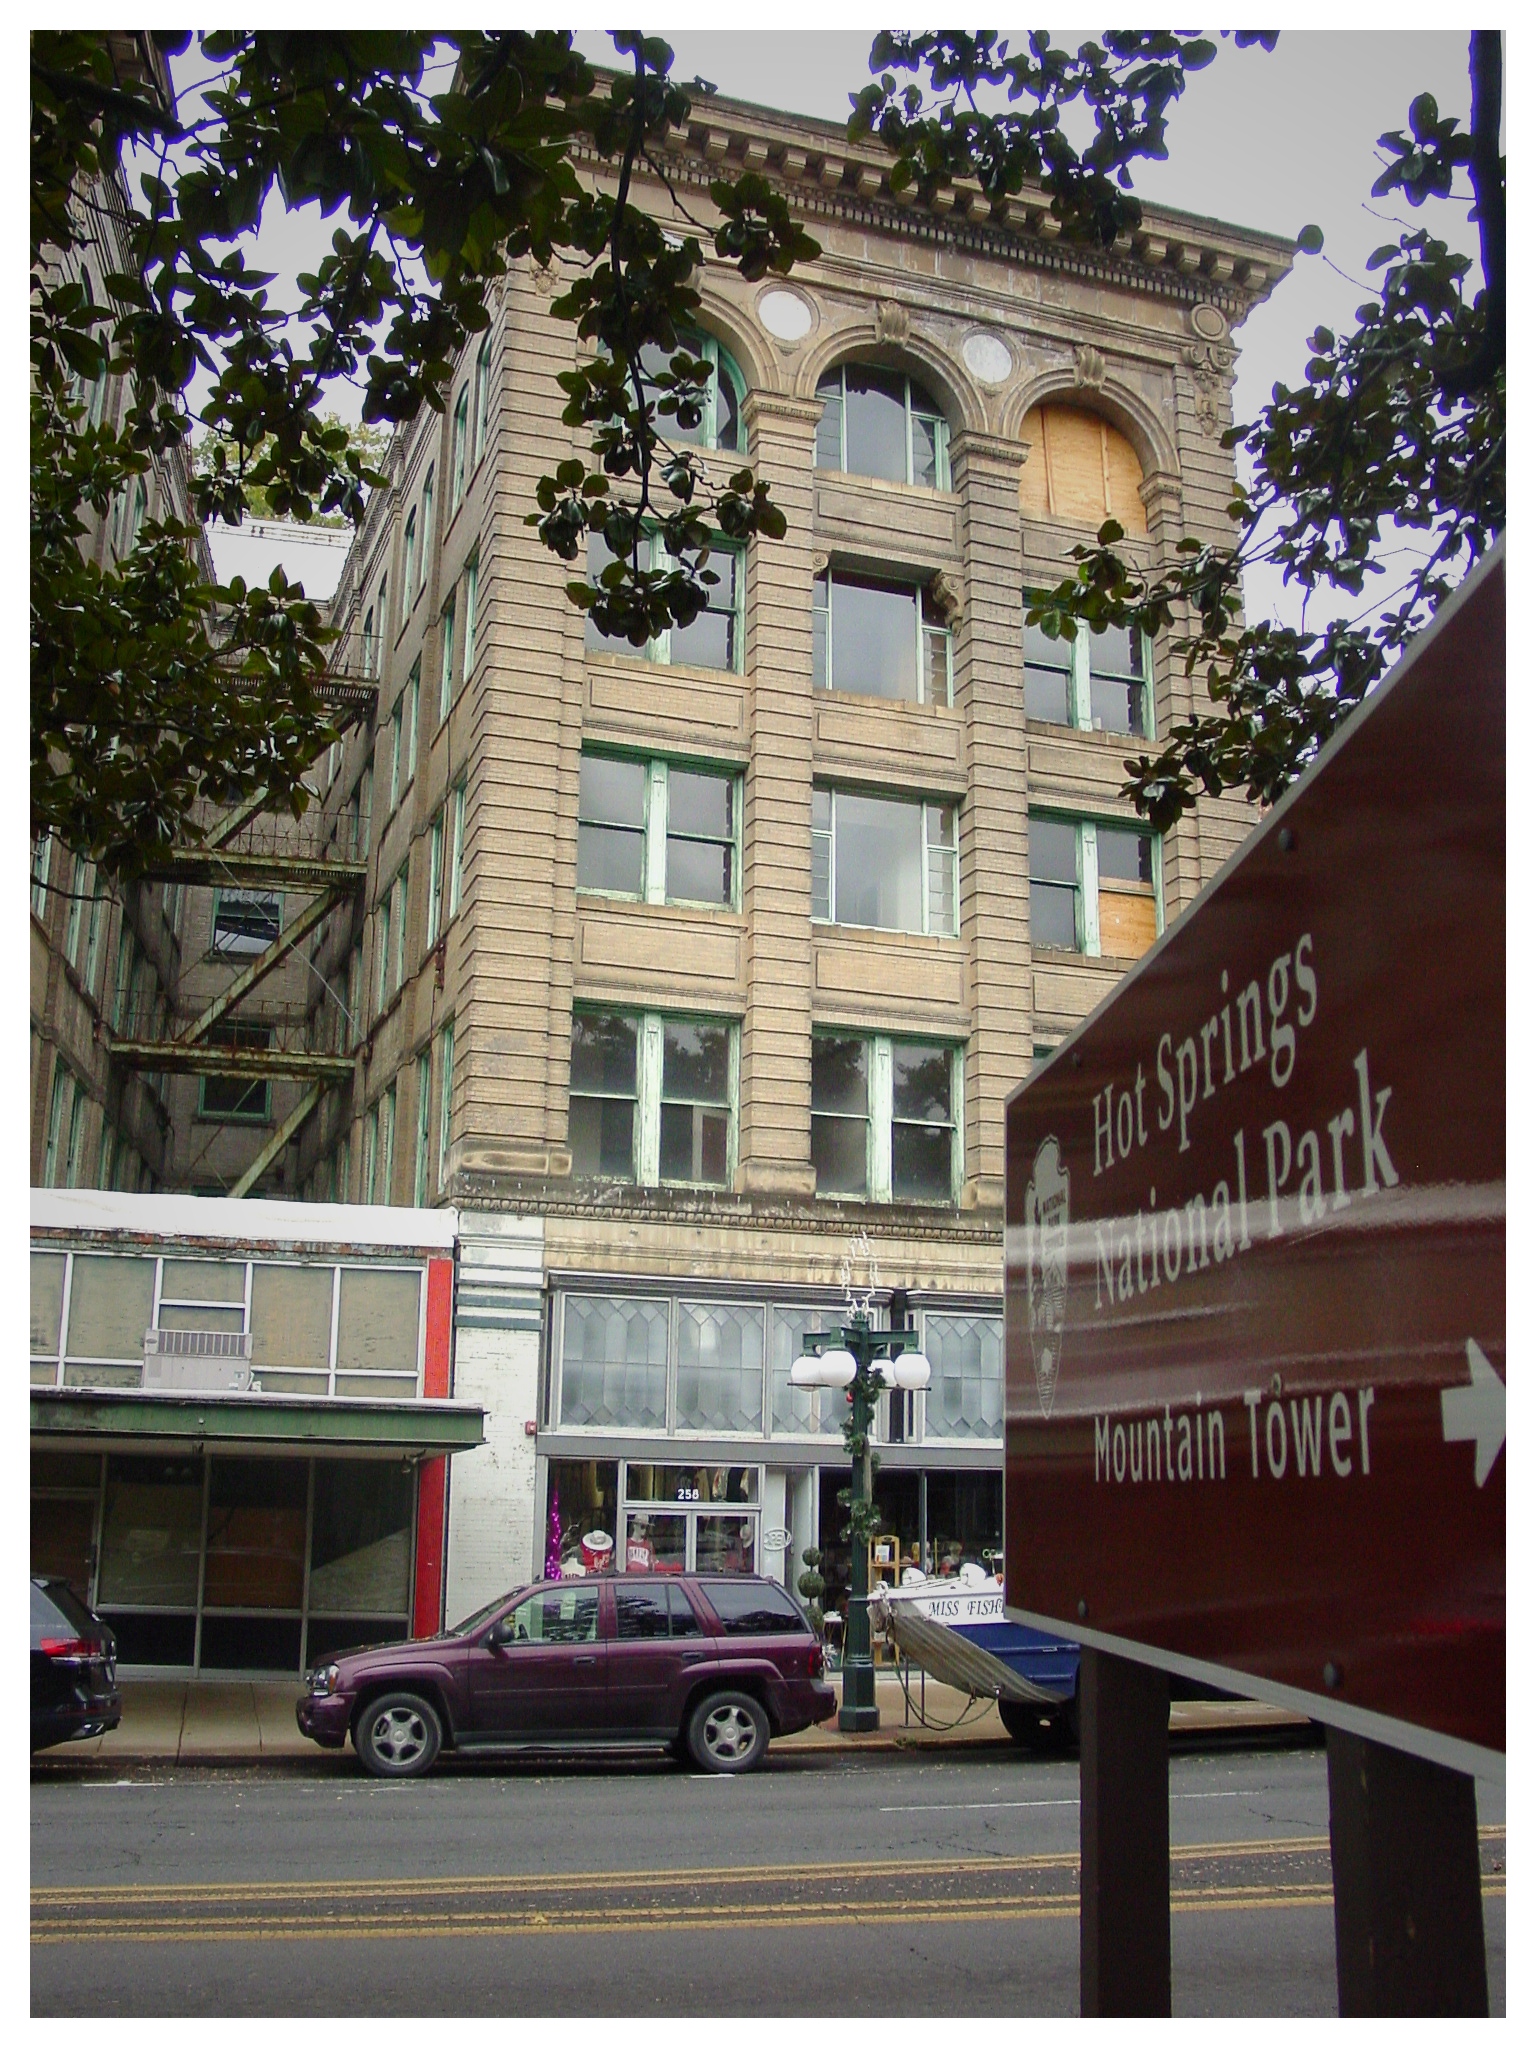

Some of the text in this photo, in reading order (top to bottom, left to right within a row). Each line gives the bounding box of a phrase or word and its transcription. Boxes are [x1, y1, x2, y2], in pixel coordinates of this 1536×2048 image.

[1092, 933, 1319, 1177] Hot Springs
[1095, 1049, 1399, 1309] National Park
[1095, 1386, 1375, 1482] Mountain Tower
[677, 1488, 700, 1500] 258
[929, 1600, 960, 1617] MISS
